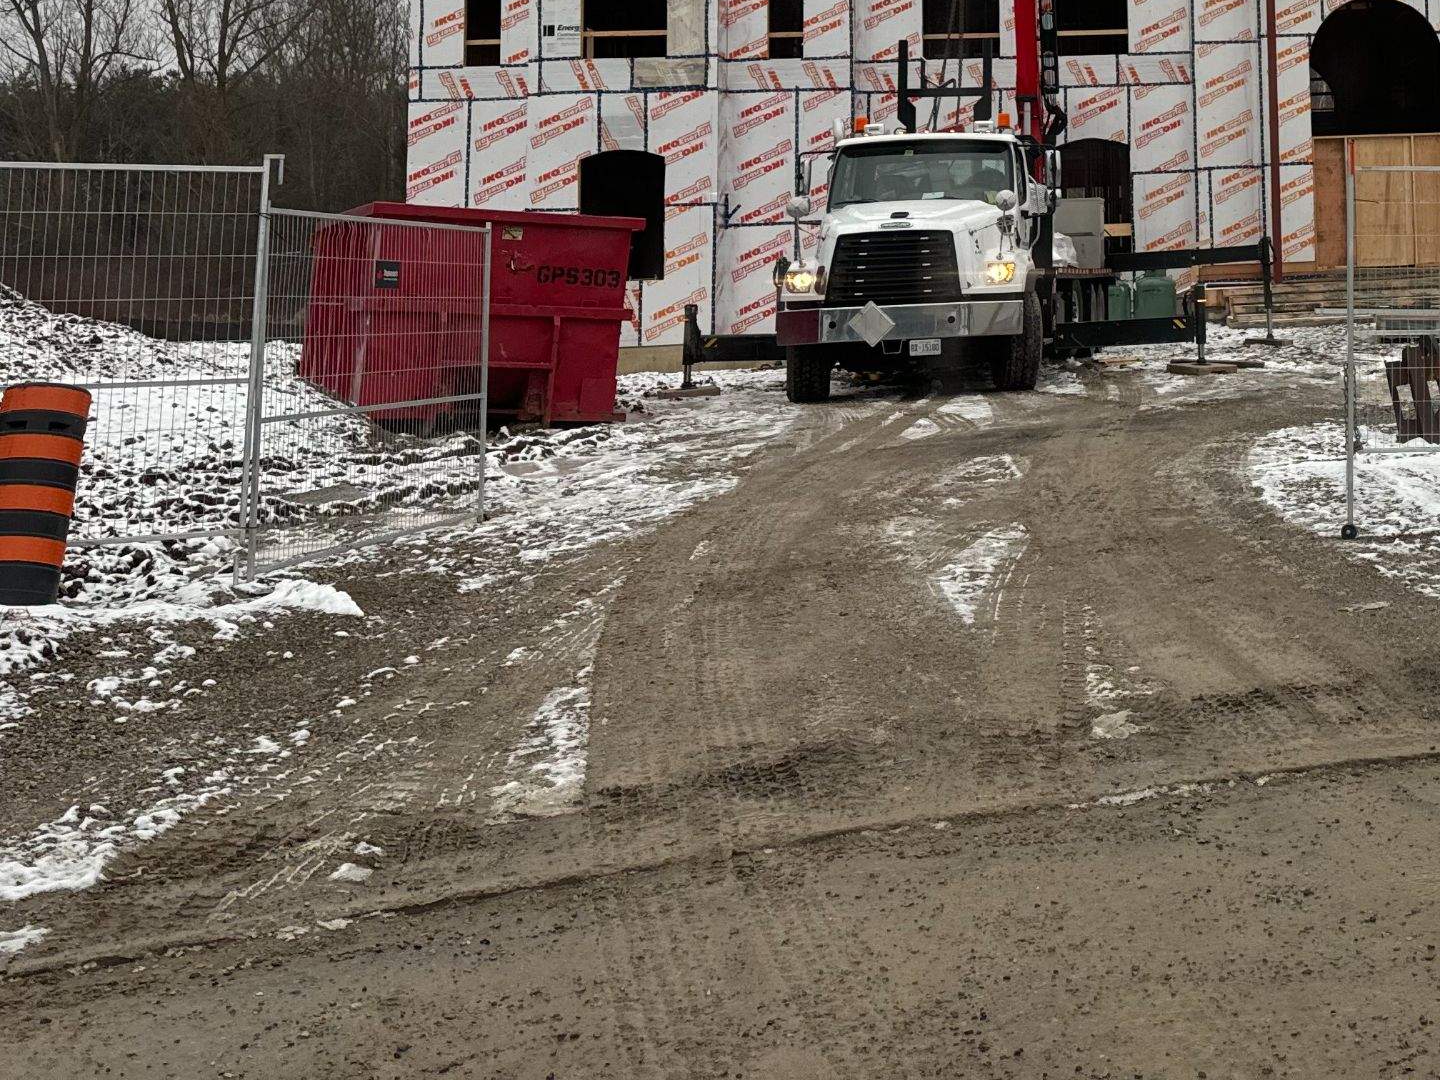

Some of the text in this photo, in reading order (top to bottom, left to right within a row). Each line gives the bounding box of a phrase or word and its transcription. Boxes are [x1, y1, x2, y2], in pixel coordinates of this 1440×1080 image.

[894, 2, 912, 15] IKO
[435, 13, 456, 27] IKO
[821, 20, 841, 33] IKO
[507, 50, 529, 63] IKO
[729, 45, 749, 58] IKO
[740, 104, 761, 118] IKO
[764, 107, 784, 120] IKO
[410, 115, 431, 128] IKO
[434, 117, 454, 130] IKO
[483, 118, 504, 131] IKO
[507, 120, 527, 133] IKO
[539, 115, 561, 128] IKO
[563, 117, 585, 131] IKO
[1142, 118, 1160, 130] IKO
[811, 131, 832, 144] IKO
[658, 140, 679, 154] IKO
[682, 142, 704, 157] IKO
[740, 157, 762, 170] IKO
[764, 159, 784, 173] IKO
[409, 169, 430, 182] IKO
[432, 171, 453, 185] IKO
[482, 172, 503, 185] IKO
[506, 174, 525, 187] IKO
[538, 169, 560, 184] IKO
[1242, 175, 1262, 188] IKO
[740, 209, 762, 223] IKO
[678, 254, 699, 267] IKO
[740, 248, 760, 262] IKO
[763, 250, 783, 264] IKO
[537, 265, 620, 289] GPS303
[653, 307, 675, 320] IKO
[739, 302, 759, 315] IKO
